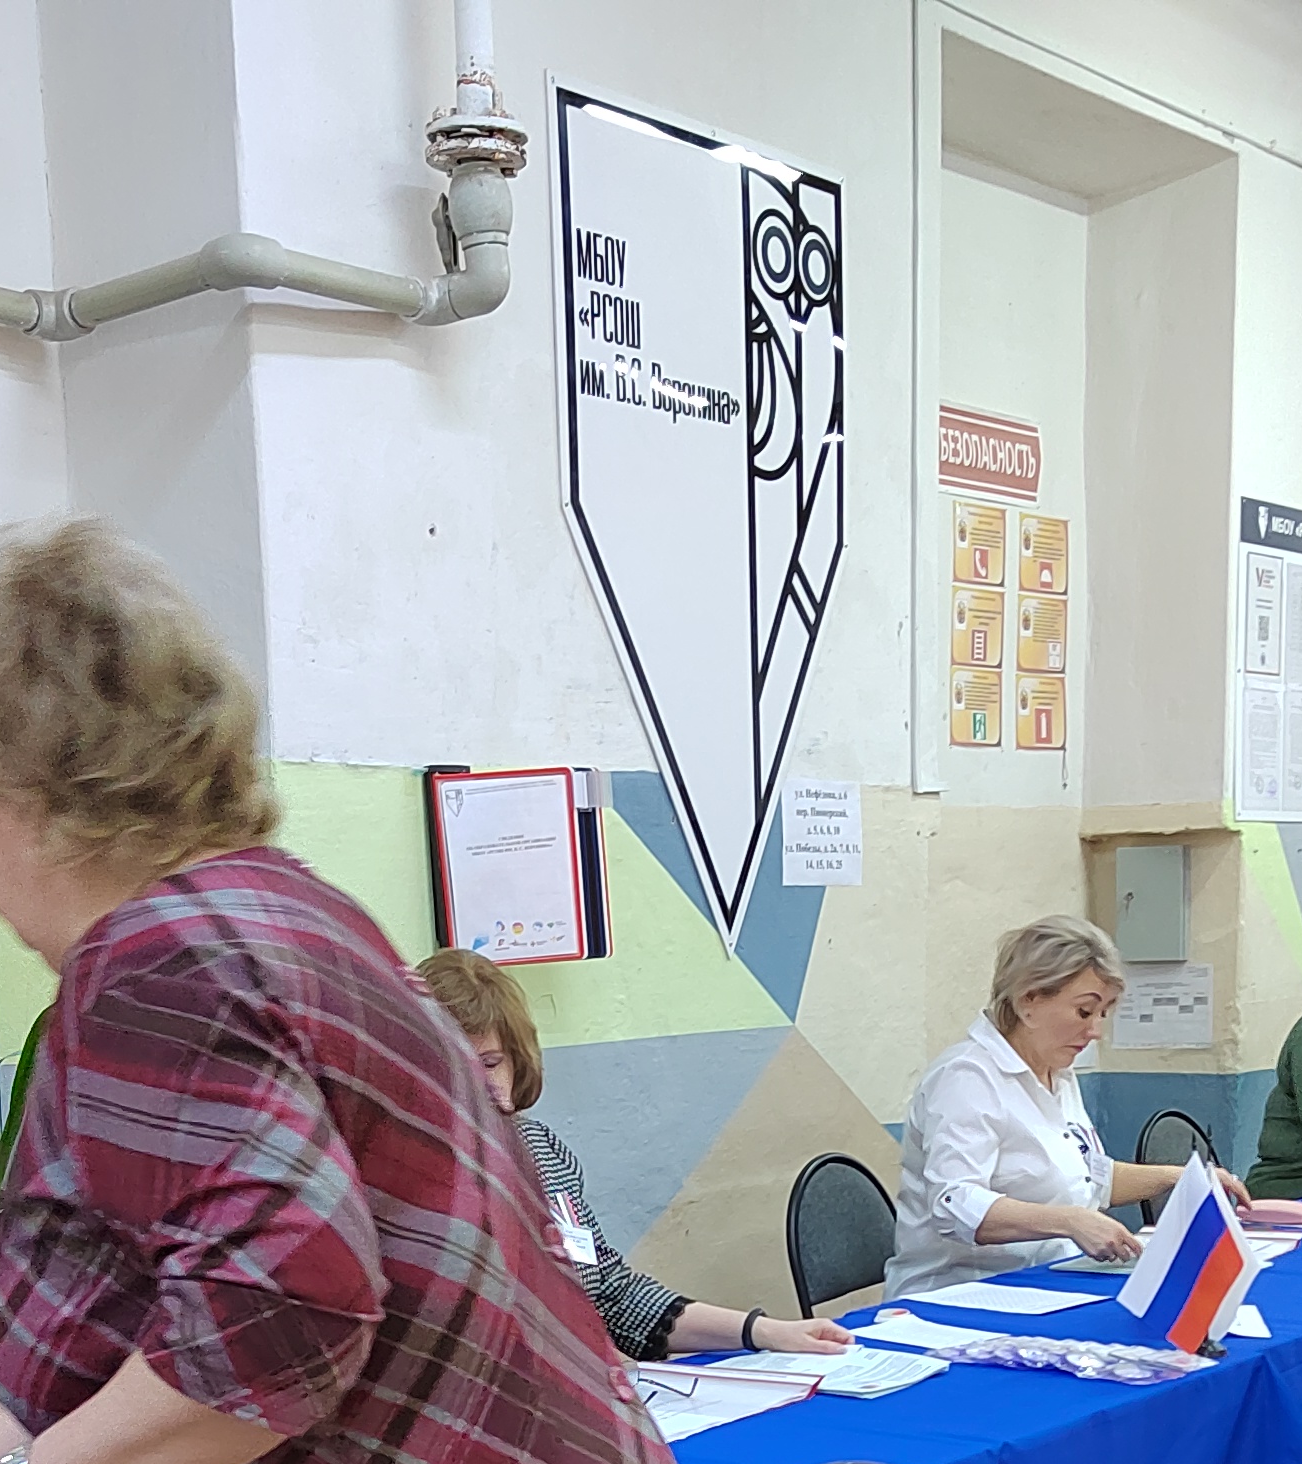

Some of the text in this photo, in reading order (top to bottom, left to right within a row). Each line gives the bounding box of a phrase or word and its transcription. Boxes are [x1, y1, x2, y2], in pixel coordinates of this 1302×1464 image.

[576, 228, 626, 288] МБОУ
[579, 290, 641, 350] «РСОШ
[579, 359, 611, 399] им.
[939, 427, 1036, 479] БЕЗОПАСНОСТЬ
